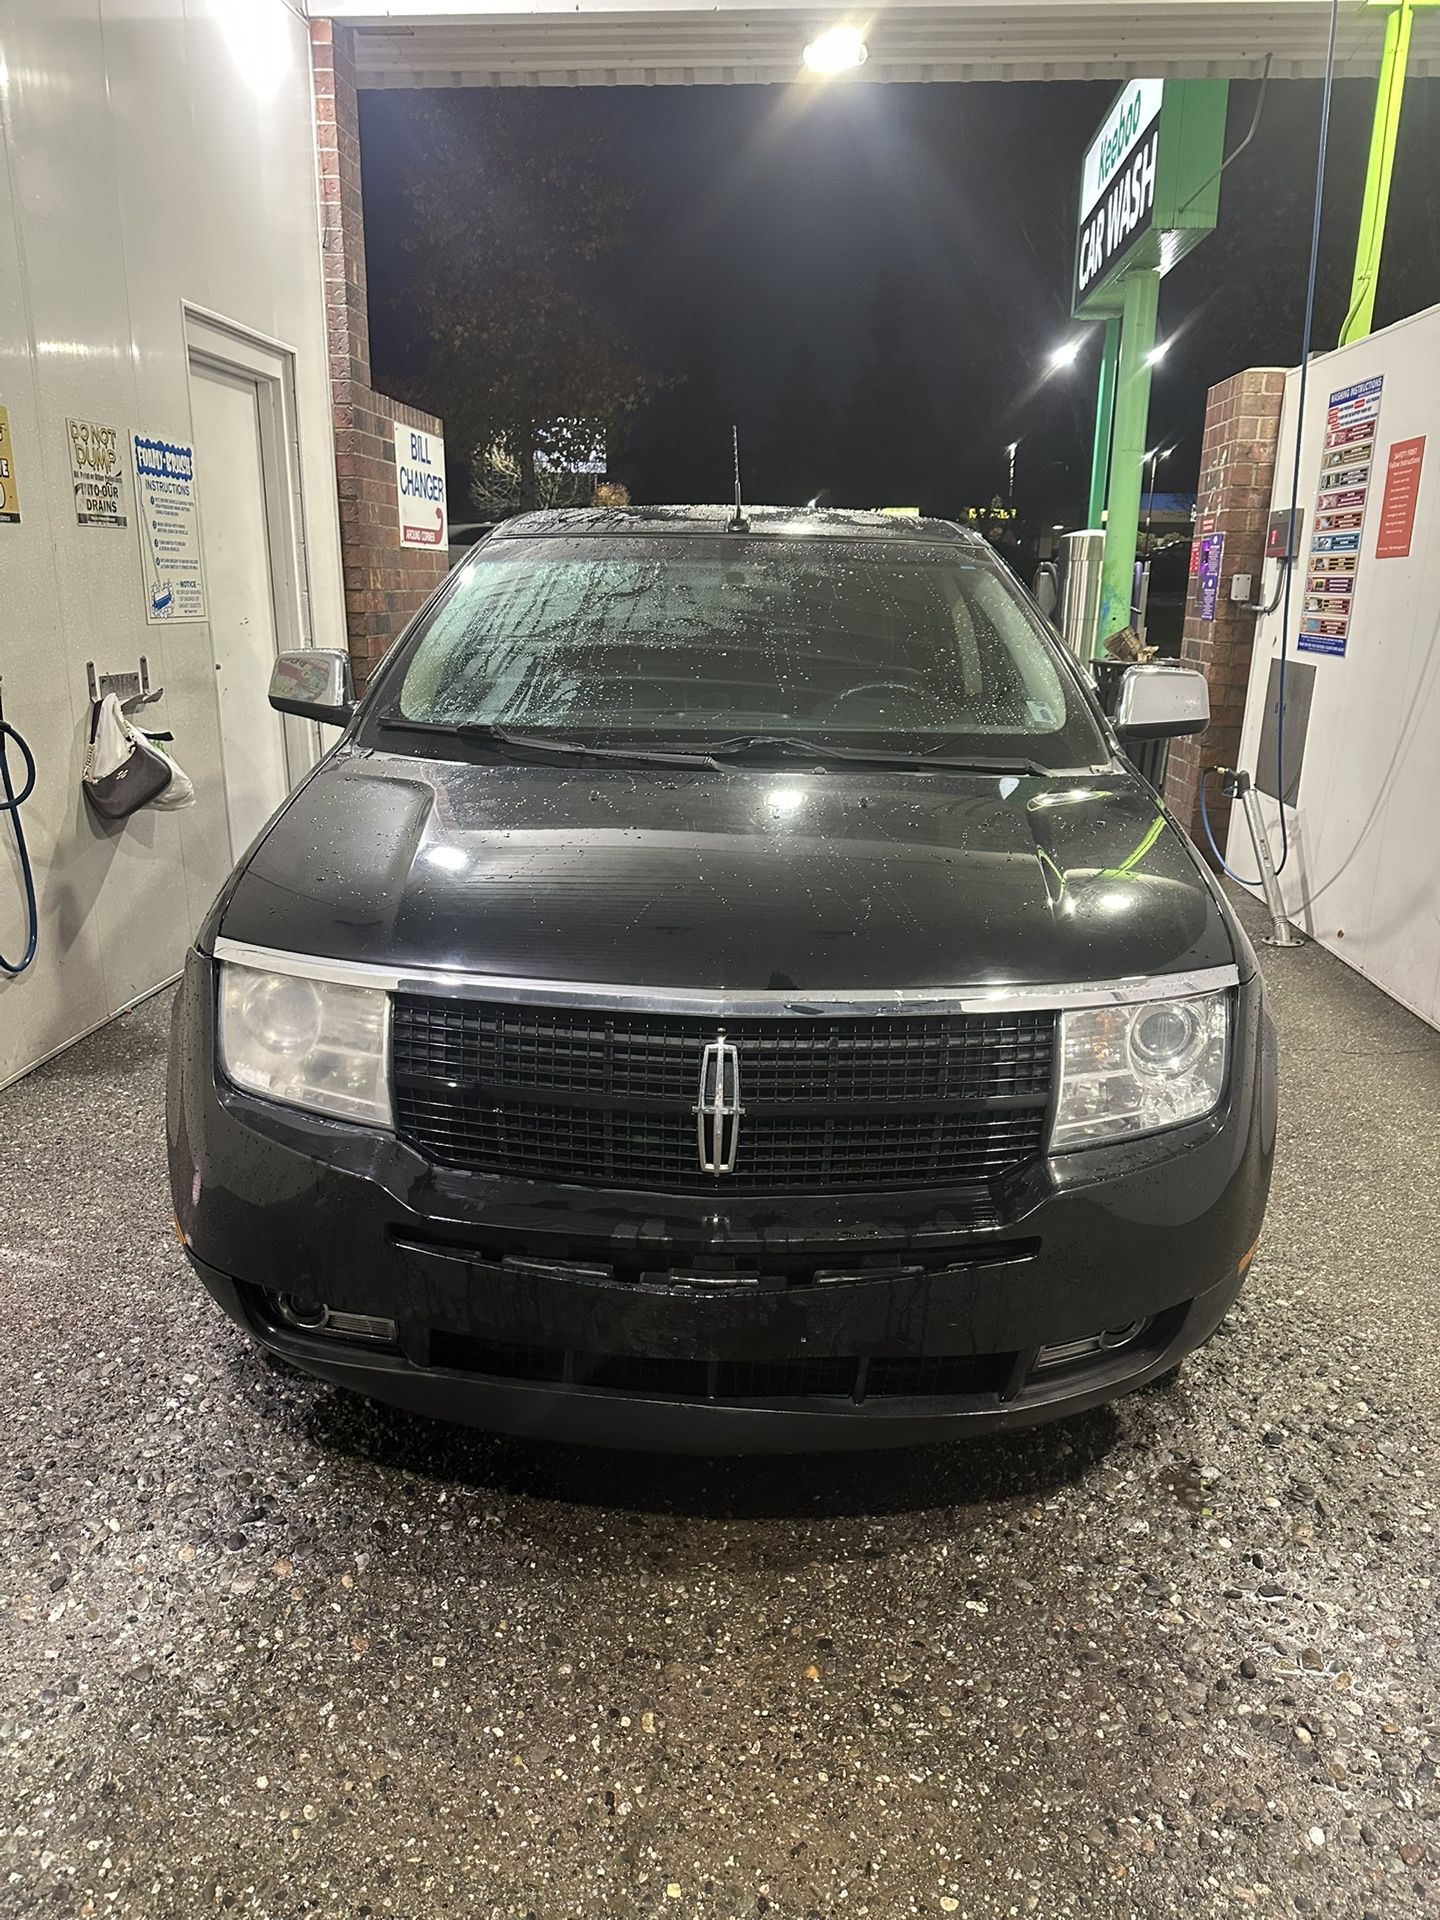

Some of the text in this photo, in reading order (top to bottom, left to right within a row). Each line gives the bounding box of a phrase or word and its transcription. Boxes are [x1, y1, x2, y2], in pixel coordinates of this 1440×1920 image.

[1097, 89, 1141, 190] Keeboo
[1079, 130, 1159, 291] CAR WASH
[1330, 388, 1350, 404] WASHING
[1350, 377, 1382, 397] INSTRUCTIONS
[69, 420, 116, 450] DO NOT
[410, 432, 432, 465] BILL
[74, 443, 117, 475] DUMP
[101, 484, 119, 499] OUR
[145, 479, 190, 496] INSTRUCTIONS
[399, 466, 445, 503] CHANGER
[86, 498, 118, 513] DRAINS
[180, 580, 197, 588] NOTICE
